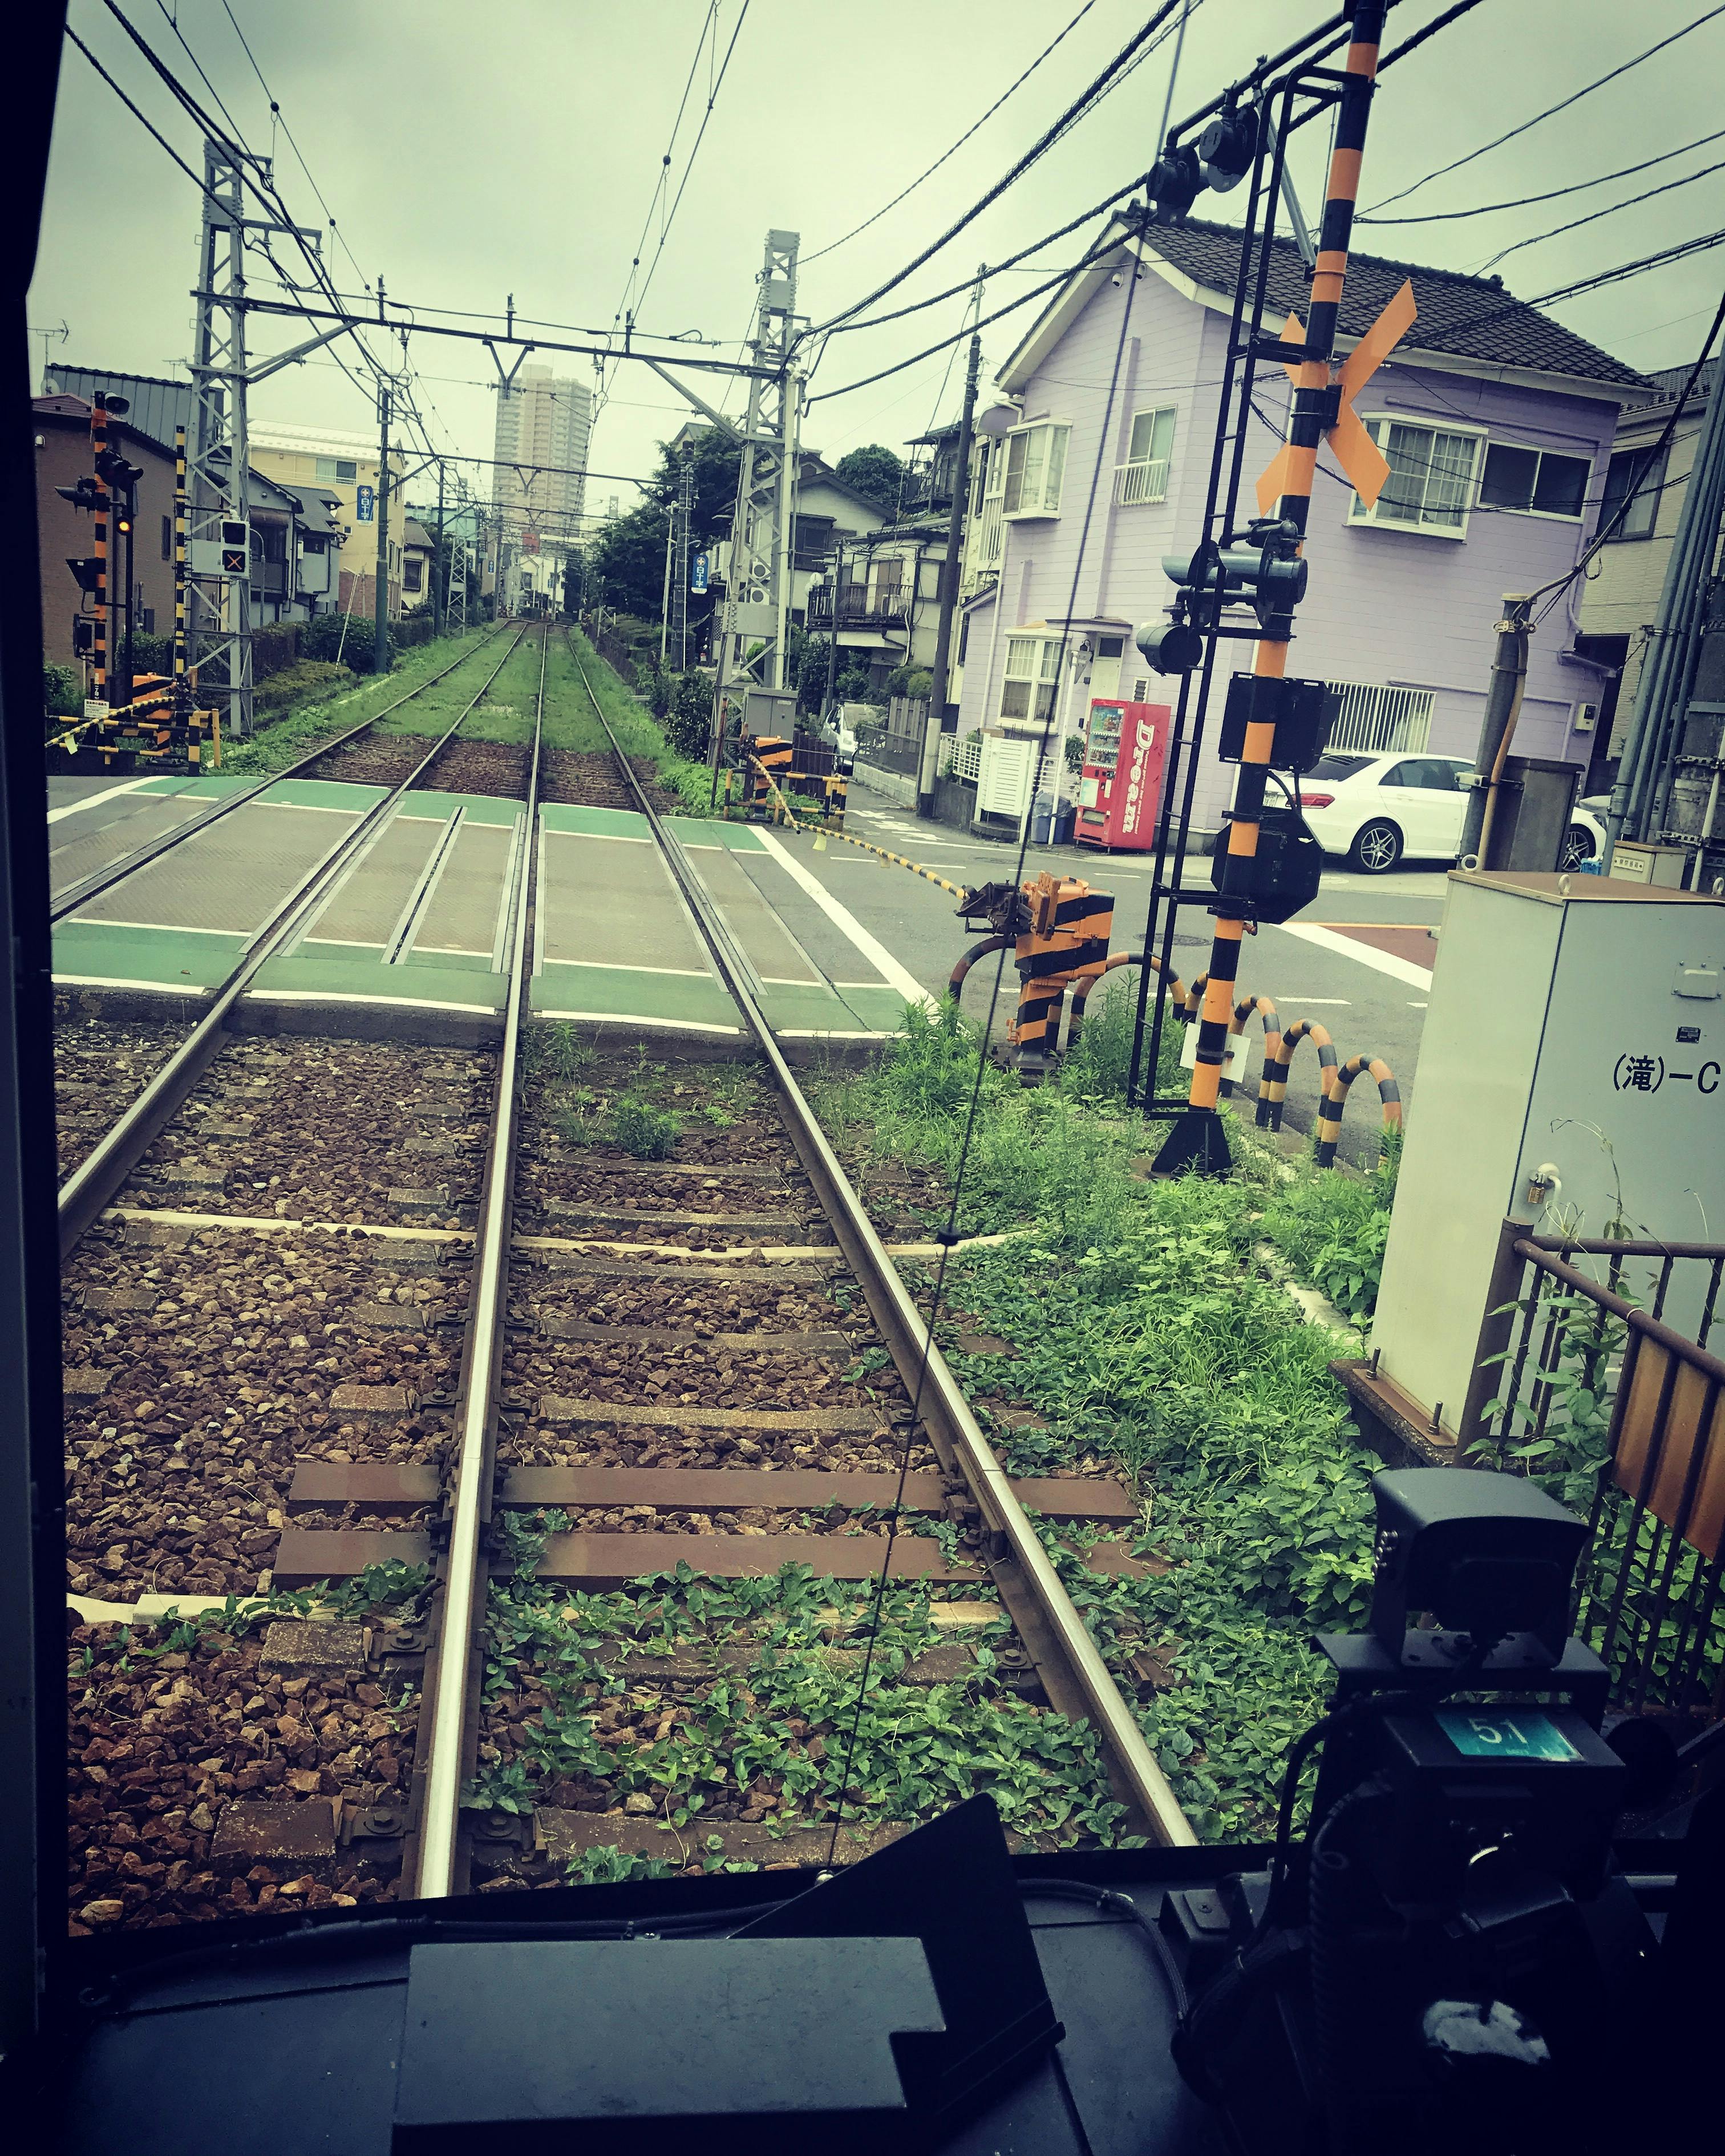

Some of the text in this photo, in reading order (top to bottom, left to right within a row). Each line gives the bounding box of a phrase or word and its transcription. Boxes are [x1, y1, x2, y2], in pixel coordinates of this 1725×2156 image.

[695, 566, 704, 587] 白十字
[1122, 719, 1155, 833] Dream
[1468, 1717, 1528, 1744] 51
